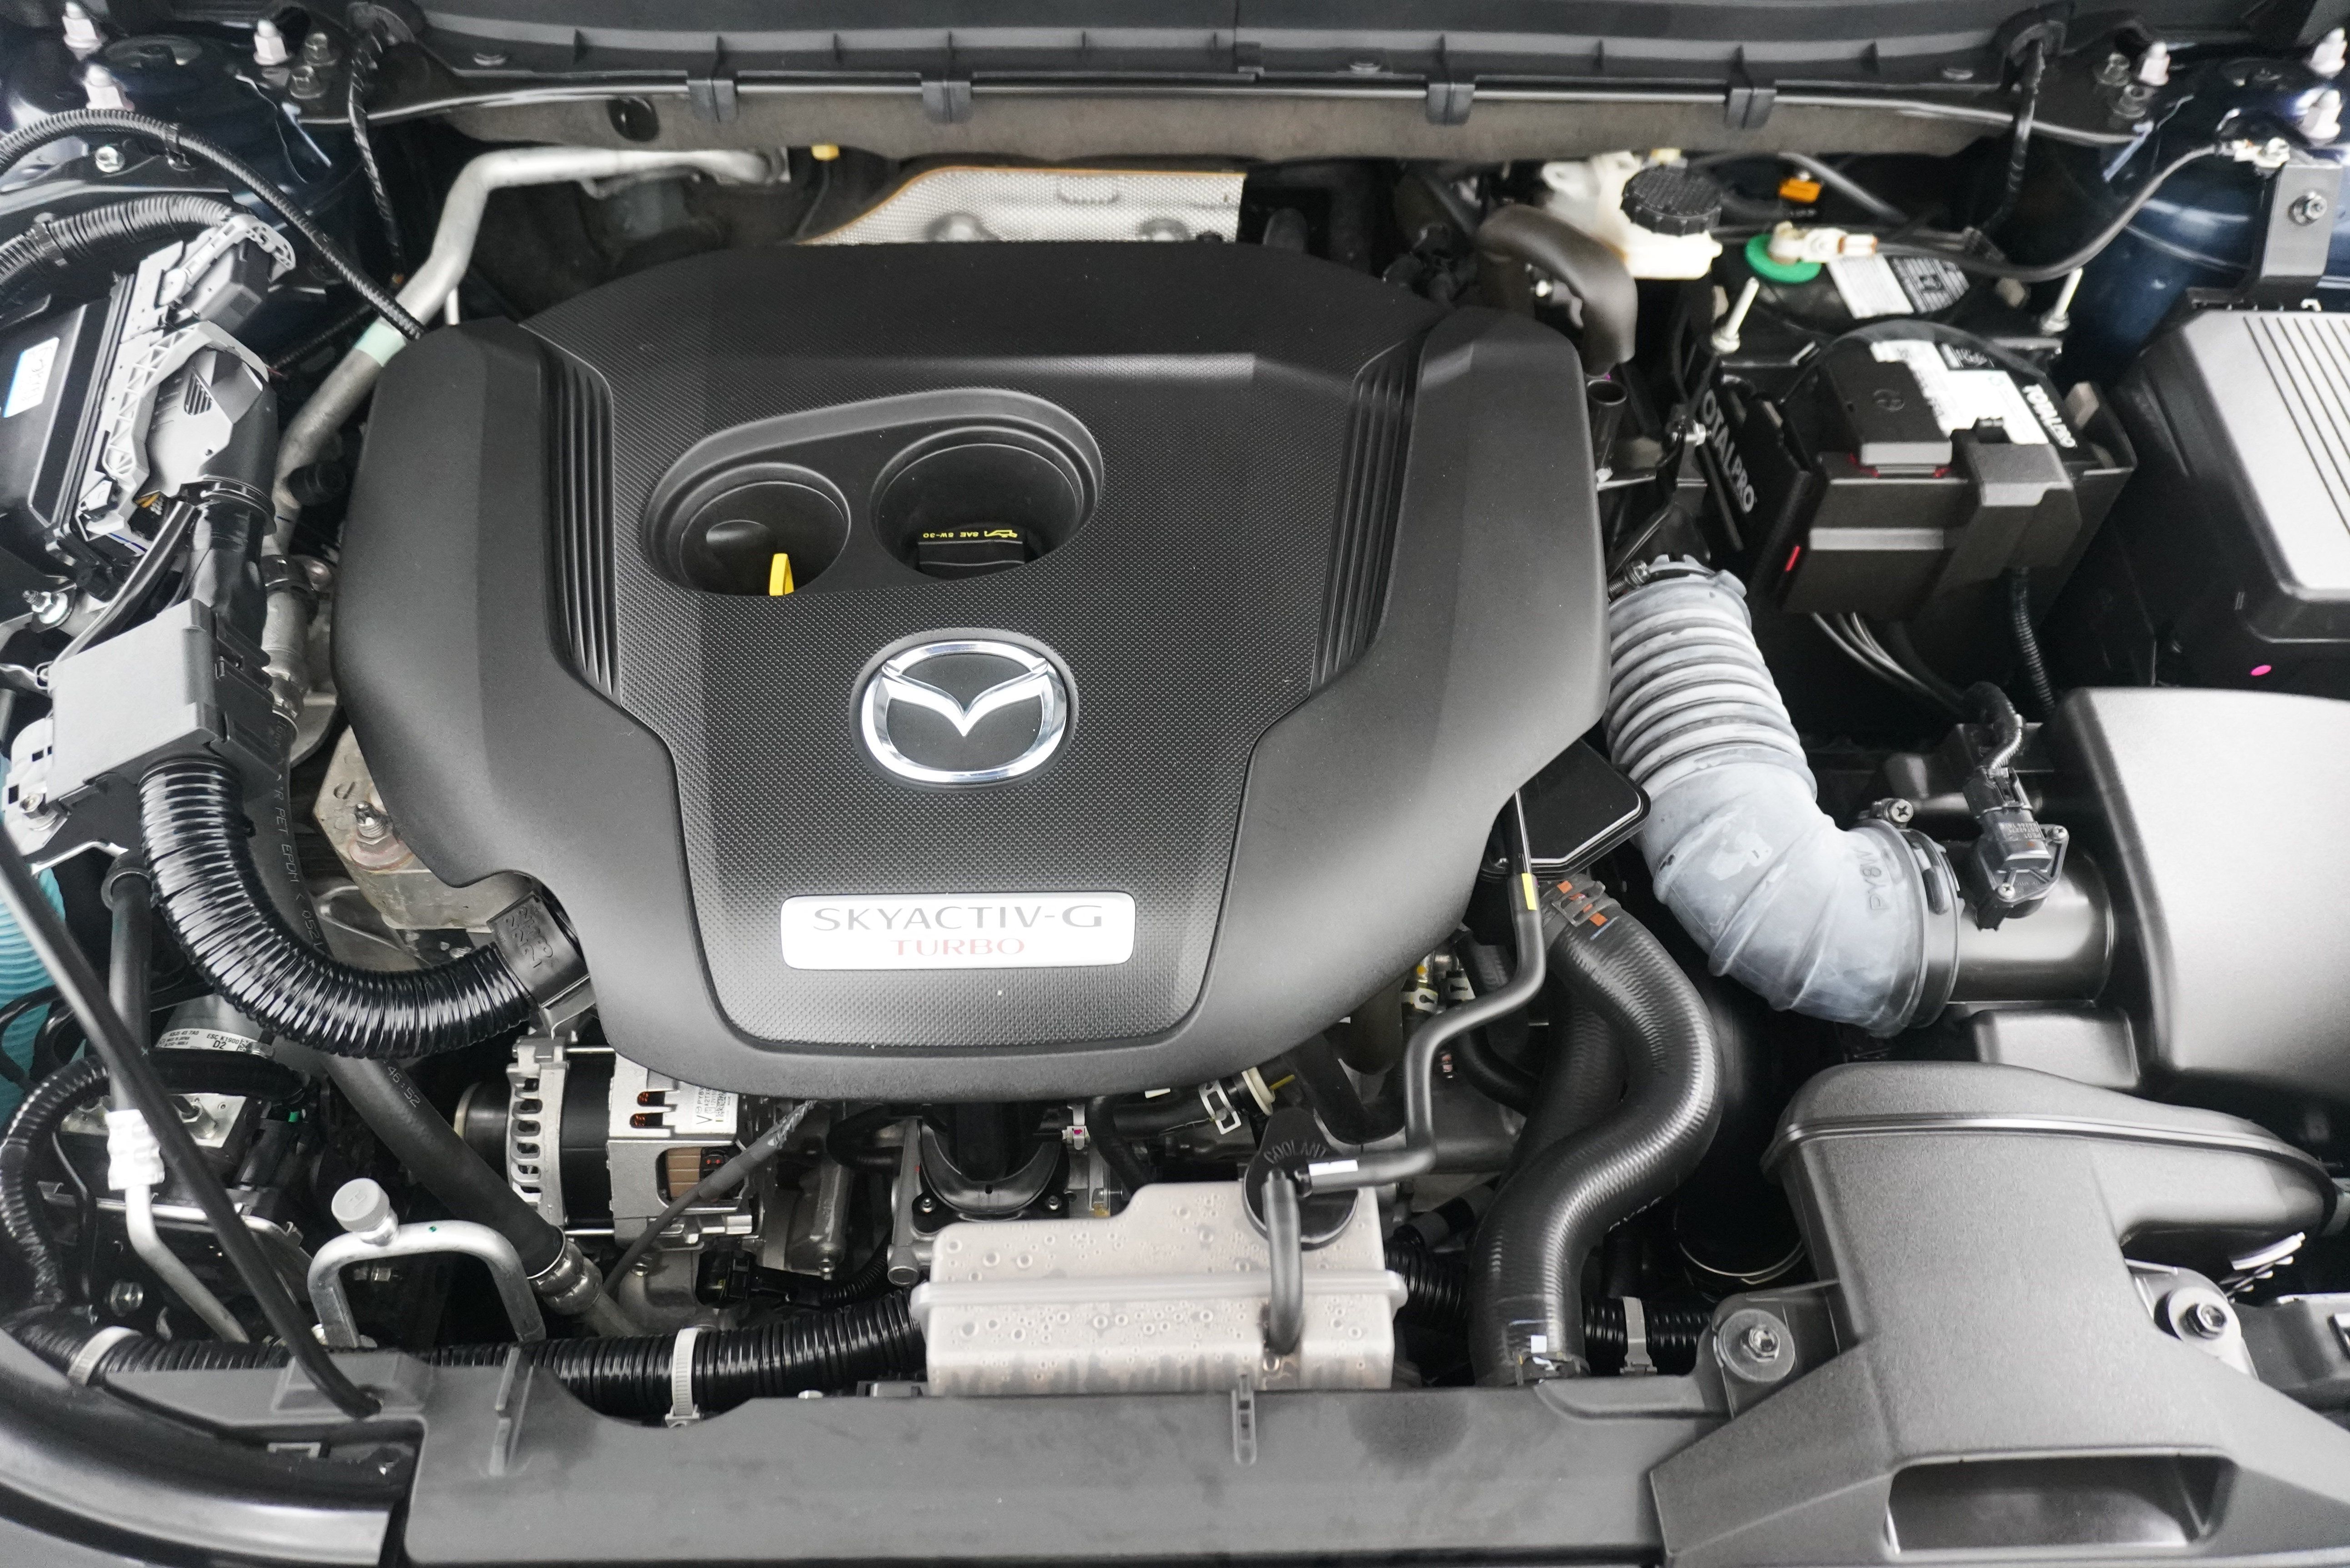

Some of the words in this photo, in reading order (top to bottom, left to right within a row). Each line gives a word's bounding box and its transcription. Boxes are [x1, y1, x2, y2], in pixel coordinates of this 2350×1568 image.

[1703, 389, 1755, 513] OTALPRO
[281, 844, 300, 882] EPDM
[813, 905, 1102, 931] SKYACTIV-G
[890, 939, 1024, 956] TURBO
[212, 1040, 226, 1050] D2
[220, 1035, 240, 1045] K1900
[1263, 1139, 1327, 1165] COOLANT
